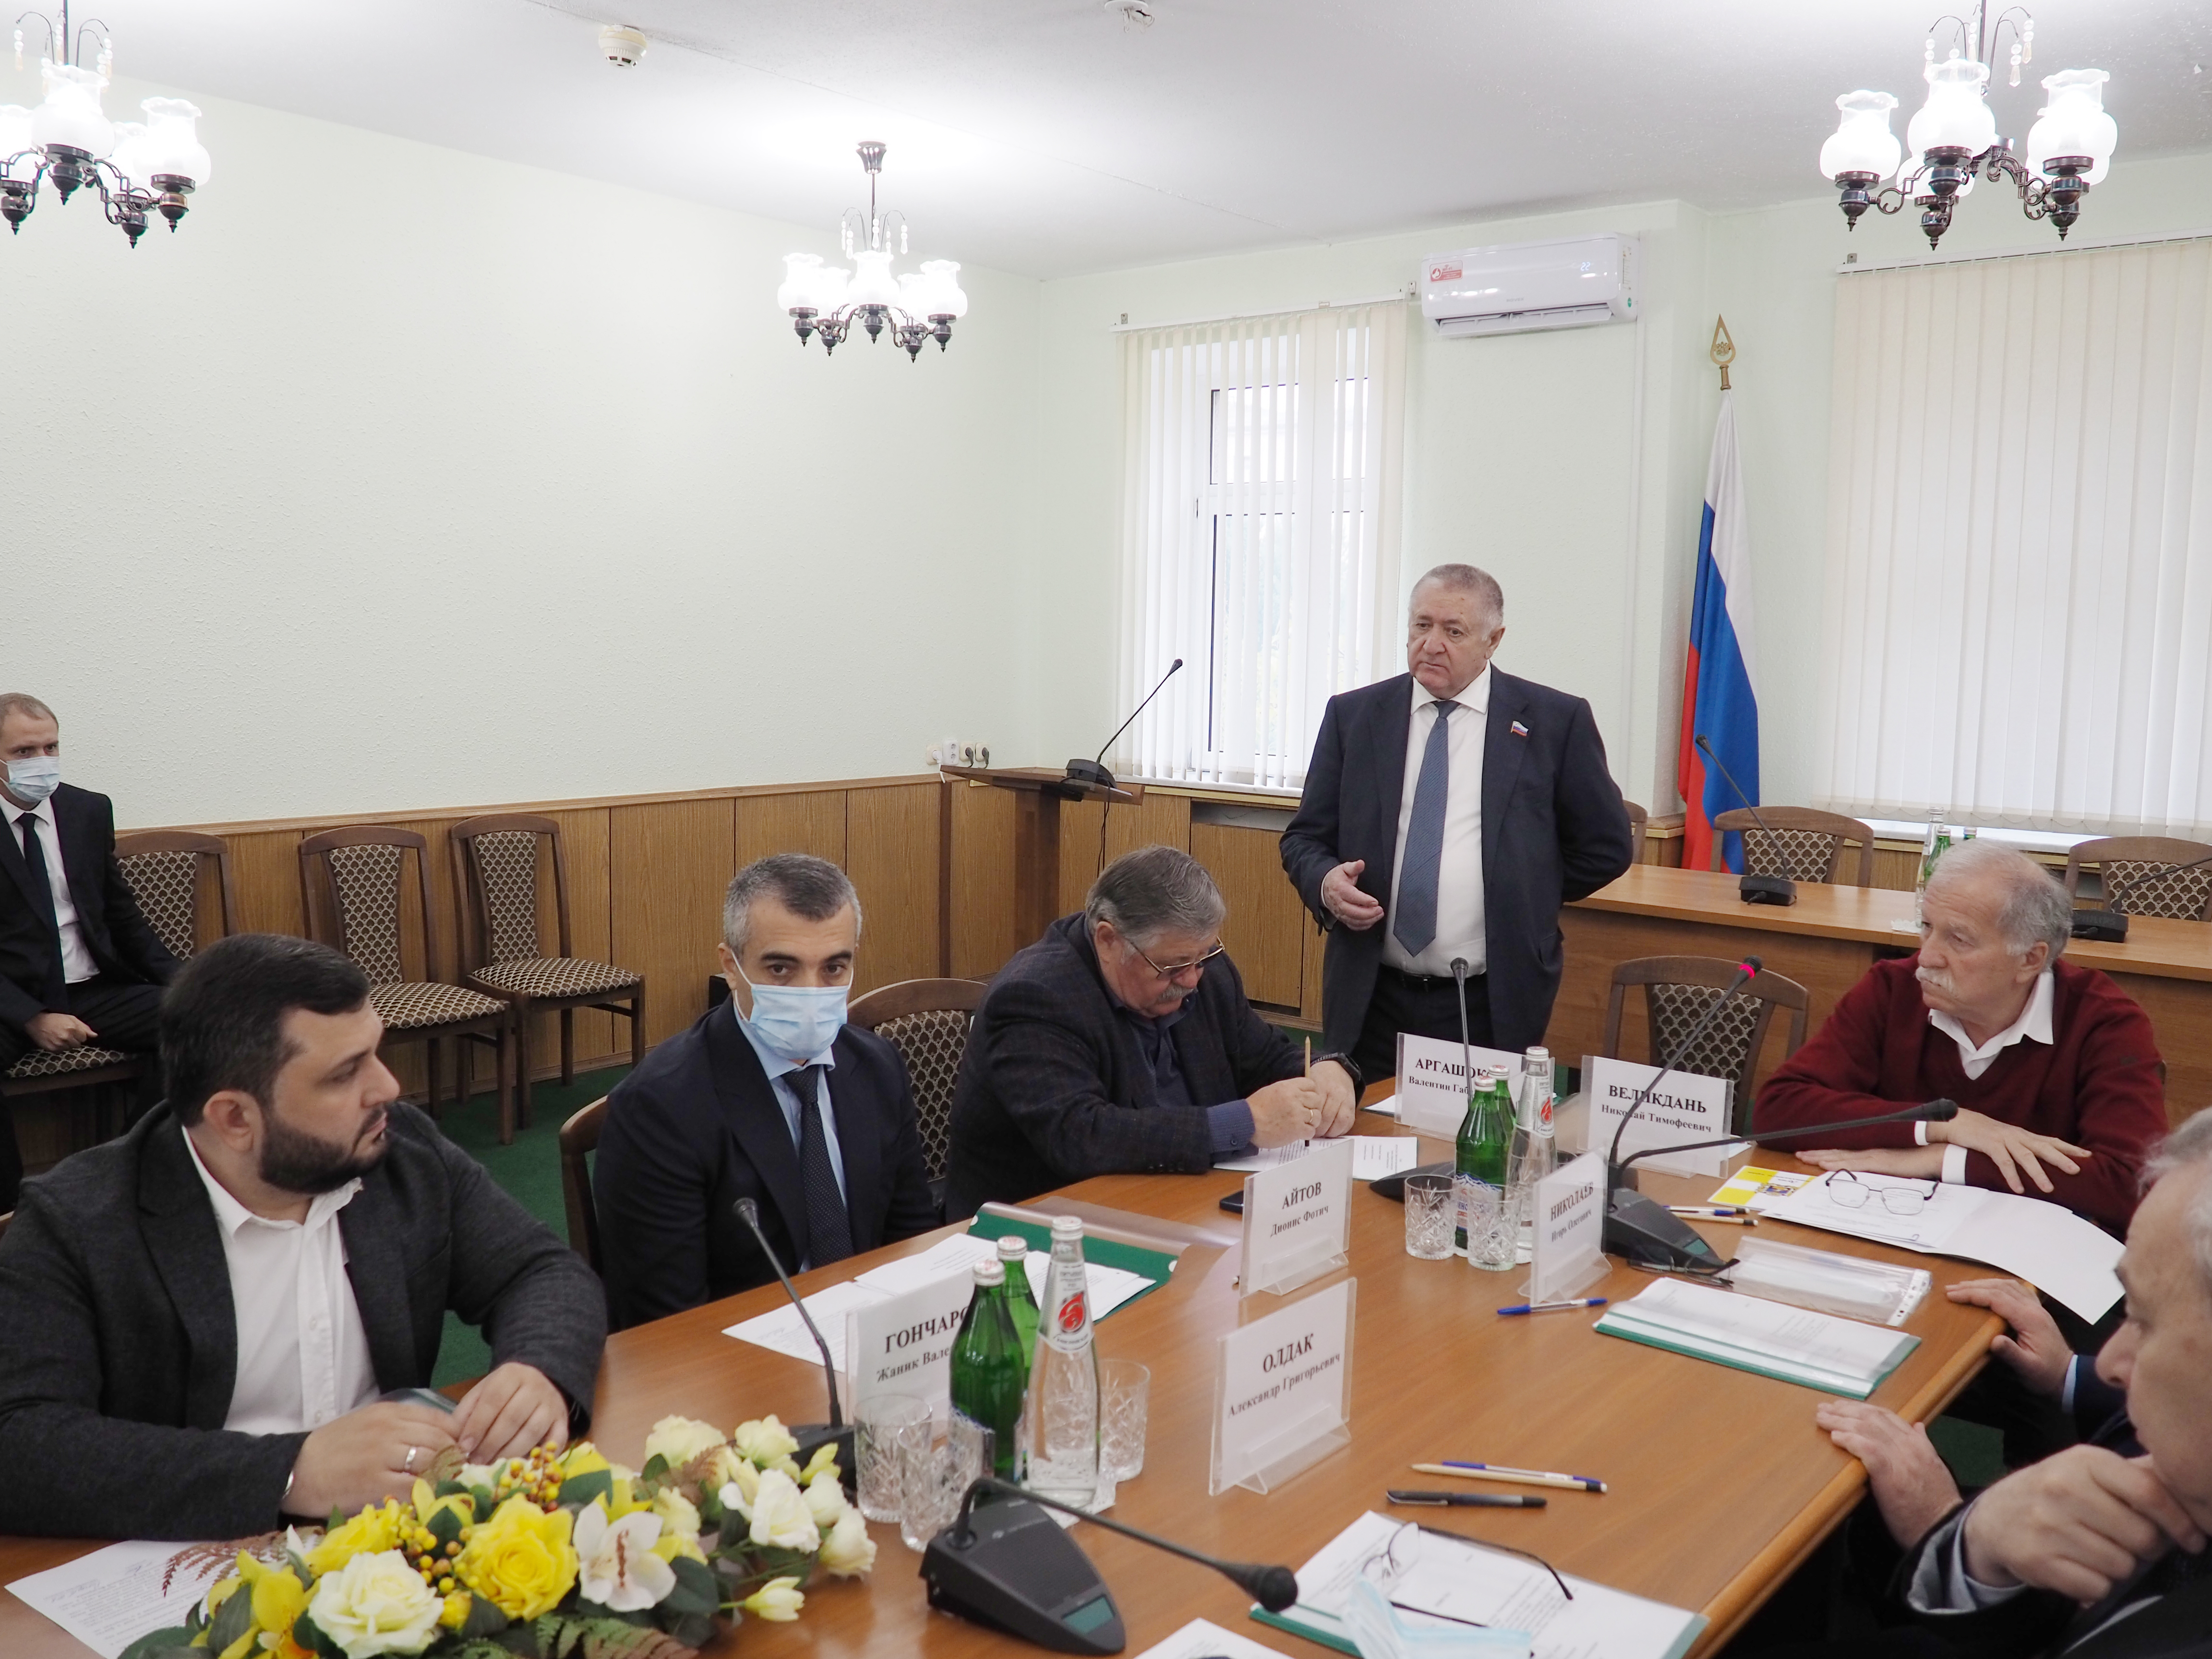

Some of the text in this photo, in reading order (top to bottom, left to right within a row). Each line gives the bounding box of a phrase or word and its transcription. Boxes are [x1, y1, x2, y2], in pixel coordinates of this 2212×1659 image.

[1580, 262, 1591, 271] 22
[1409, 1076, 1450, 1091] Валентин
[1601, 1105, 1711, 1133] Никоай Тимофеевич
[1282, 1182, 1321, 1209] АЙТОВ
[1270, 1206, 1329, 1238] Дионис Фотич
[1551, 1227, 1567, 1242] Игорь
[1263, 1333, 1314, 1373] ОЛДАК
[876, 1359, 919, 1383] Жаник
[1227, 1353, 1341, 1419] Александр Григорьевич
